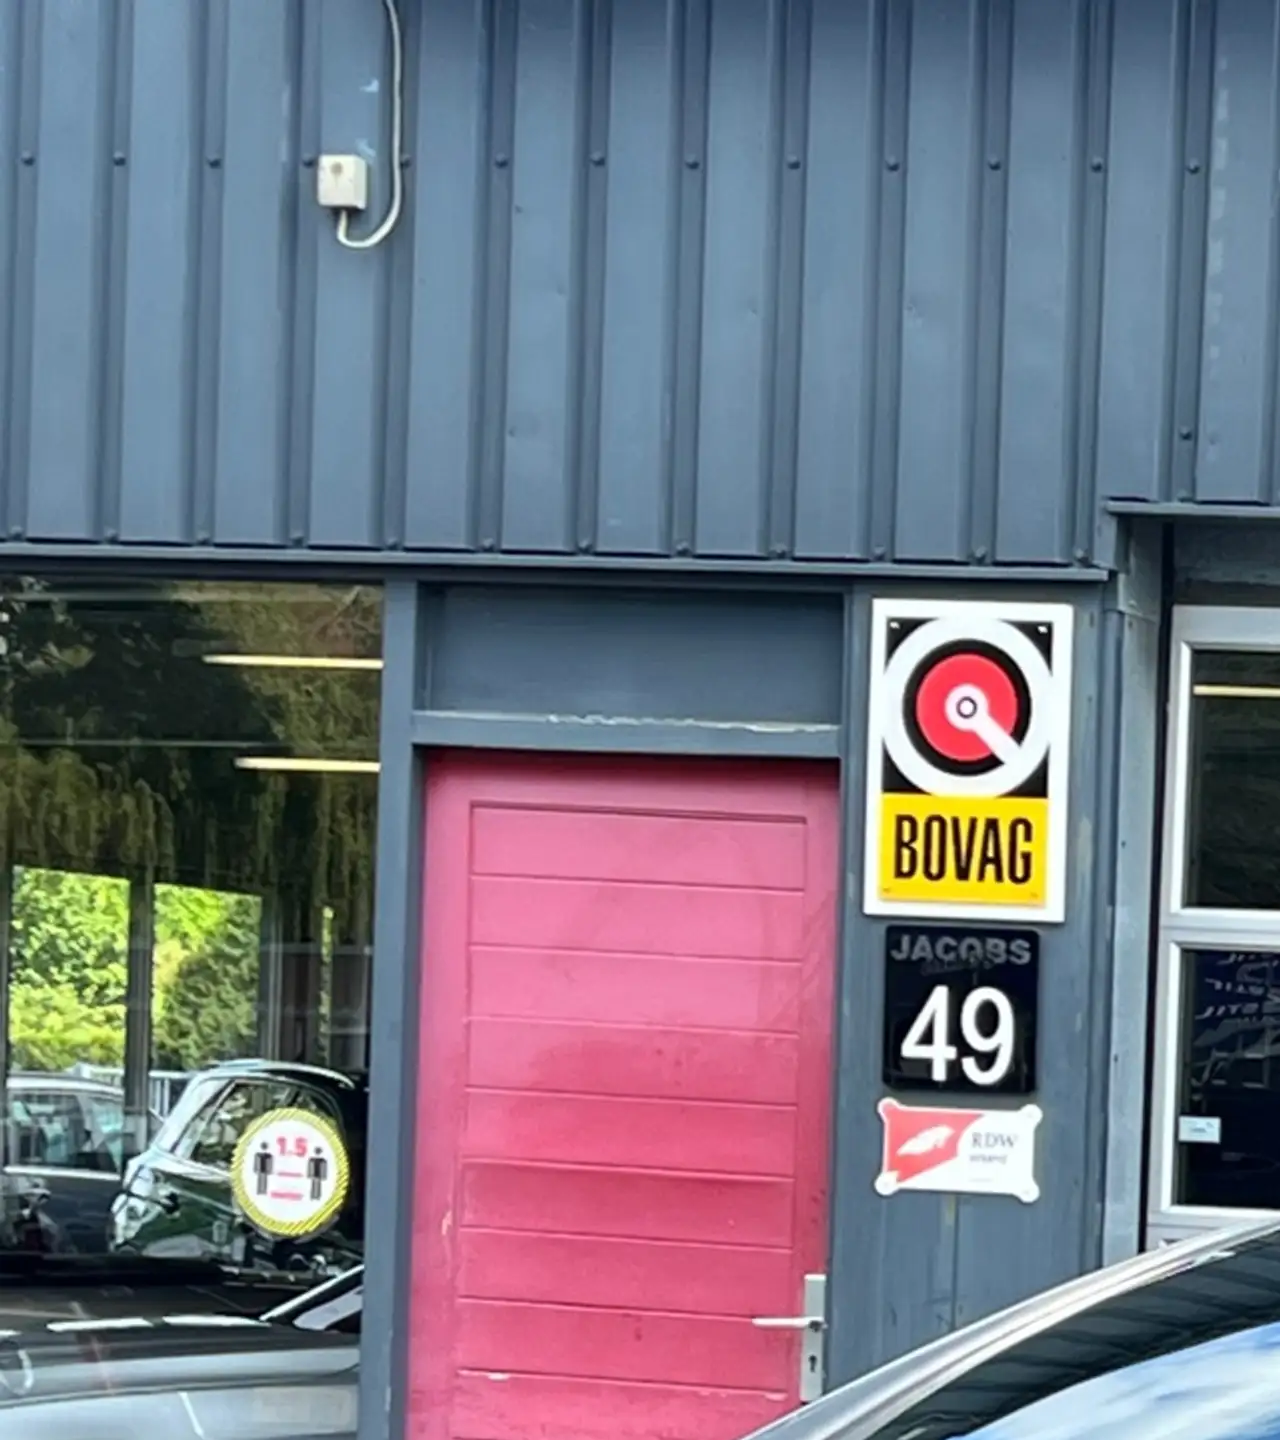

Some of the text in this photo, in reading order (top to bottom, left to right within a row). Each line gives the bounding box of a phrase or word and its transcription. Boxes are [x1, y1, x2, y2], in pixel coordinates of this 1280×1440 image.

[893, 813, 1033, 885] BOVAG
[890, 934, 1032, 966] JACOBS
[900, 984, 1015, 1085] 49
